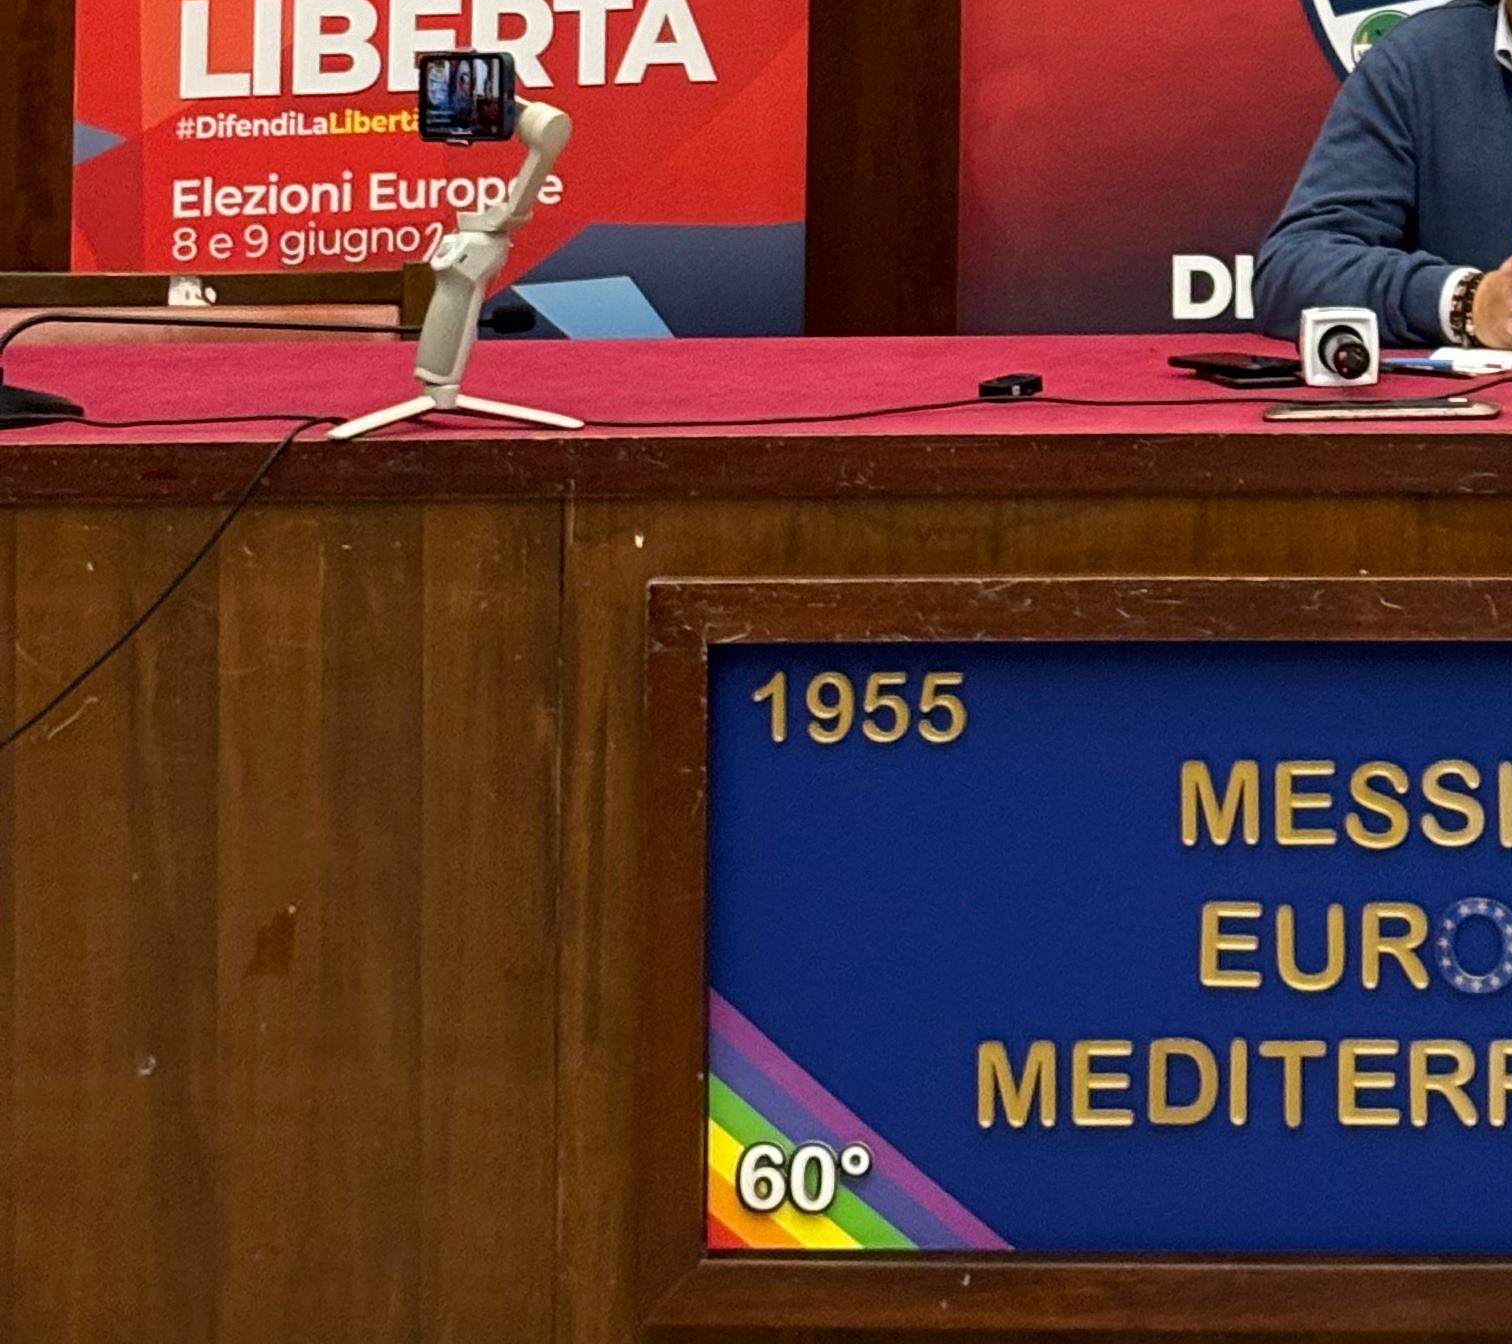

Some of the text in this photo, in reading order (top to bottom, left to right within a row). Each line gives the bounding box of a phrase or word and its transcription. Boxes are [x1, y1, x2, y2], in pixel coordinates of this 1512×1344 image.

[171, 169, 564, 218] Elezioni Europe
[171, 227, 198, 262] 8
[209, 230, 233, 260] e
[245, 223, 270, 260] 9
[280, 221, 422, 266] giugno
[749, 668, 969, 745] 1955
[735, 1141, 873, 1216] 60°
